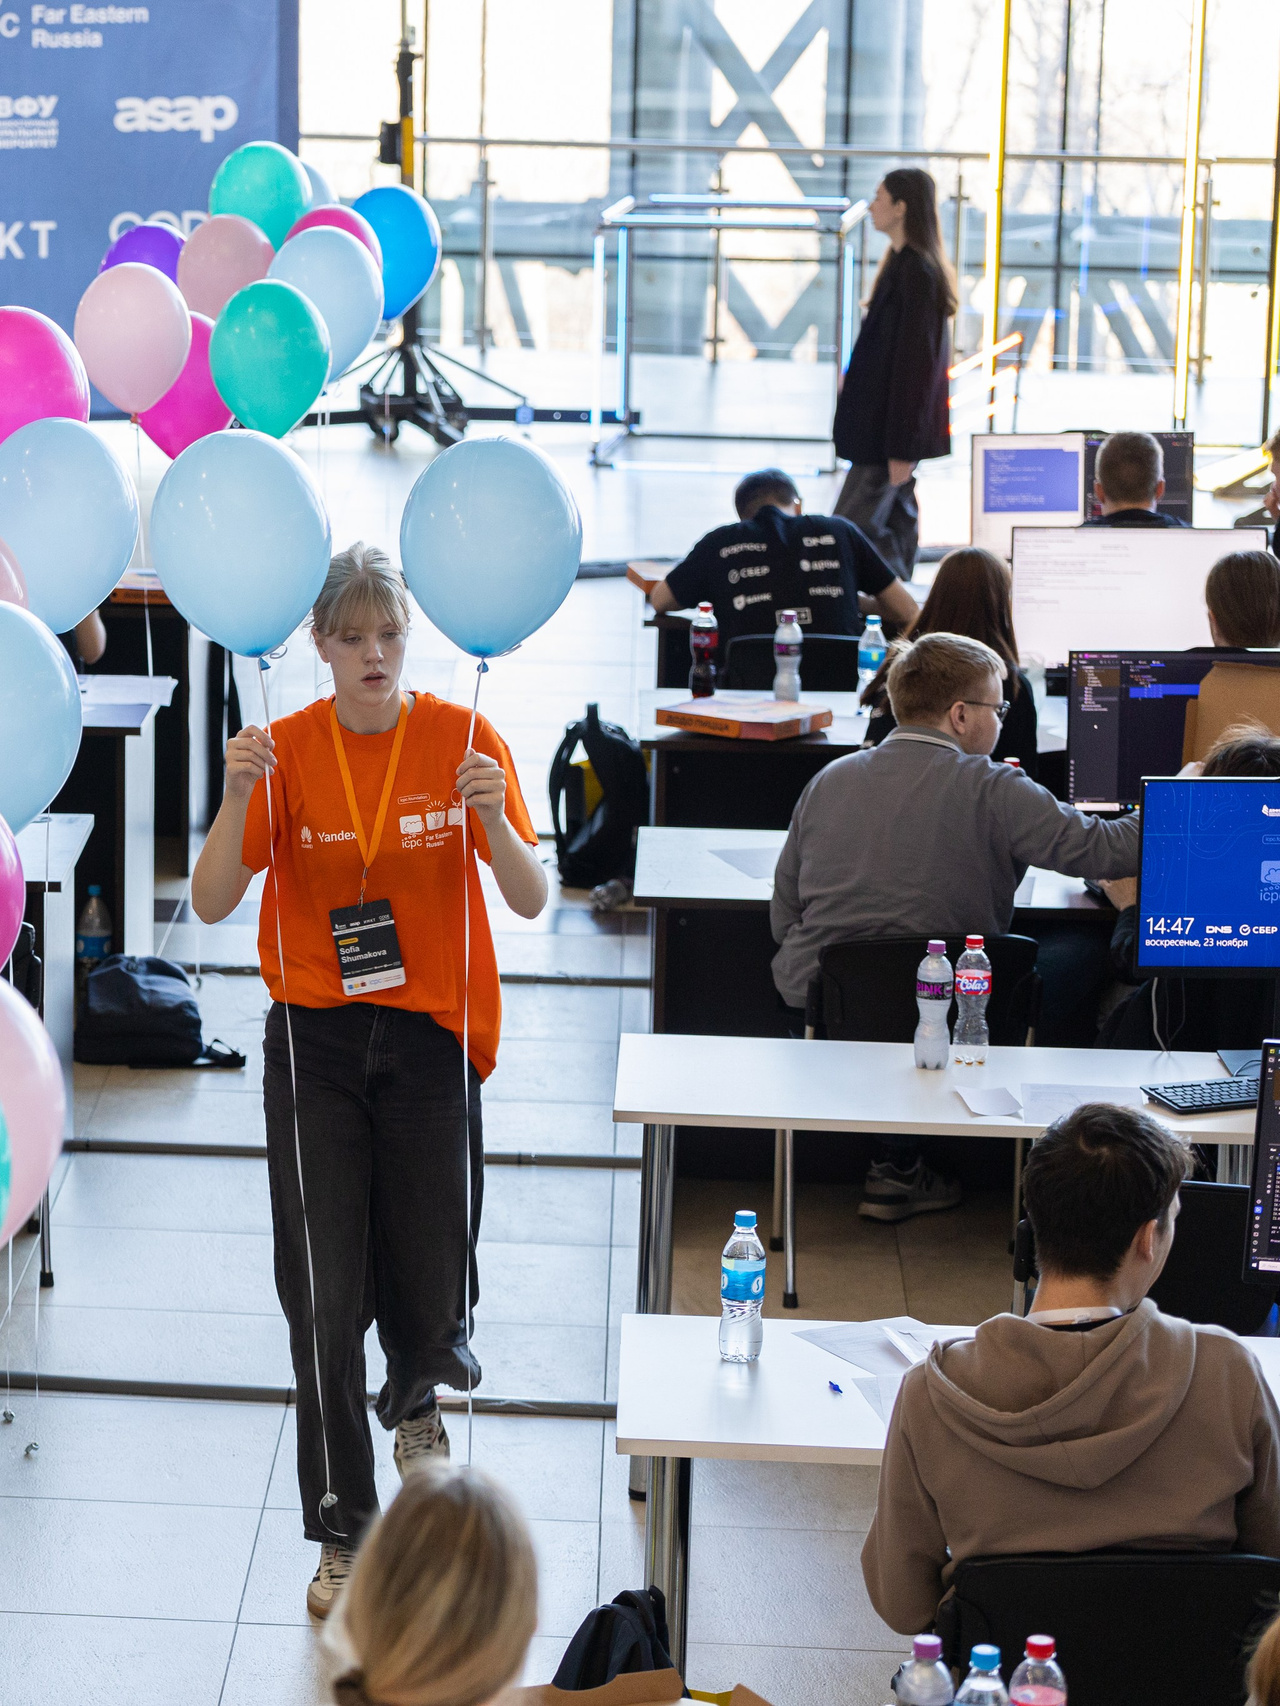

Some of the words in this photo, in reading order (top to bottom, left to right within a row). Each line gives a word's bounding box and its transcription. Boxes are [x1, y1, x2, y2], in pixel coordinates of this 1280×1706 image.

[31, 4, 67, 24] Far
[71, 4, 149, 24] Eastern
[31, 28, 103, 48] Russia
[114, 96, 238, 143] asap
[802, 535, 836, 547] DNS
[809, 584, 844, 598] nexign
[317, 830, 357, 843] Yandex
[435, 830, 453, 840] Eastern
[401, 838, 423, 850] icpc
[426, 840, 445, 849] Russia
[1146, 917, 1195, 935] 14:47
[1205, 925, 1233, 934] DNS
[1252, 926, 1278, 934] СБЕР
[1145, 938, 1201, 948] воскресенье,
[1203, 938, 1214, 947] 23
[1216, 938, 1248, 949] ноября
[339, 946, 360, 955] Sofia
[341, 949, 387, 964] Shumakova
[960, 978, 982, 991] Cola
